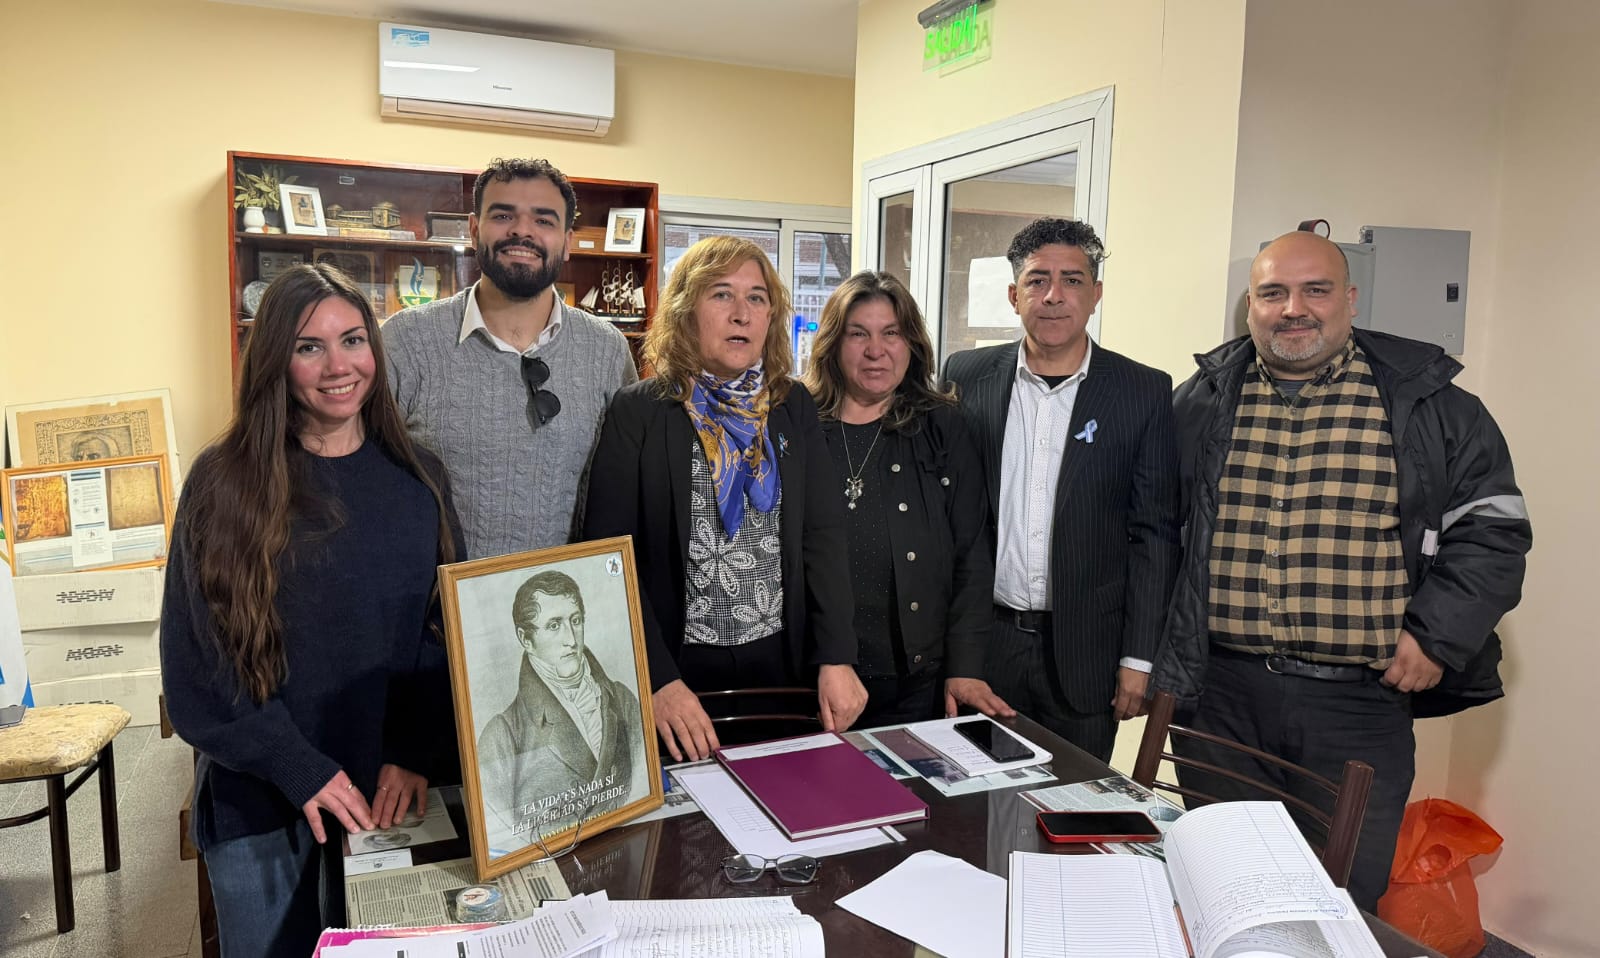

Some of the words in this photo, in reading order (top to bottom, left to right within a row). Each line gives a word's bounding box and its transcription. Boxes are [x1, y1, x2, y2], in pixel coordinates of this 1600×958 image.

[511, 821, 525, 836] LA
[591, 785, 627, 806] PIERDE.
[538, 793, 561, 810] VIDA
[578, 778, 604, 796] NADA
[605, 774, 615, 786] SI
